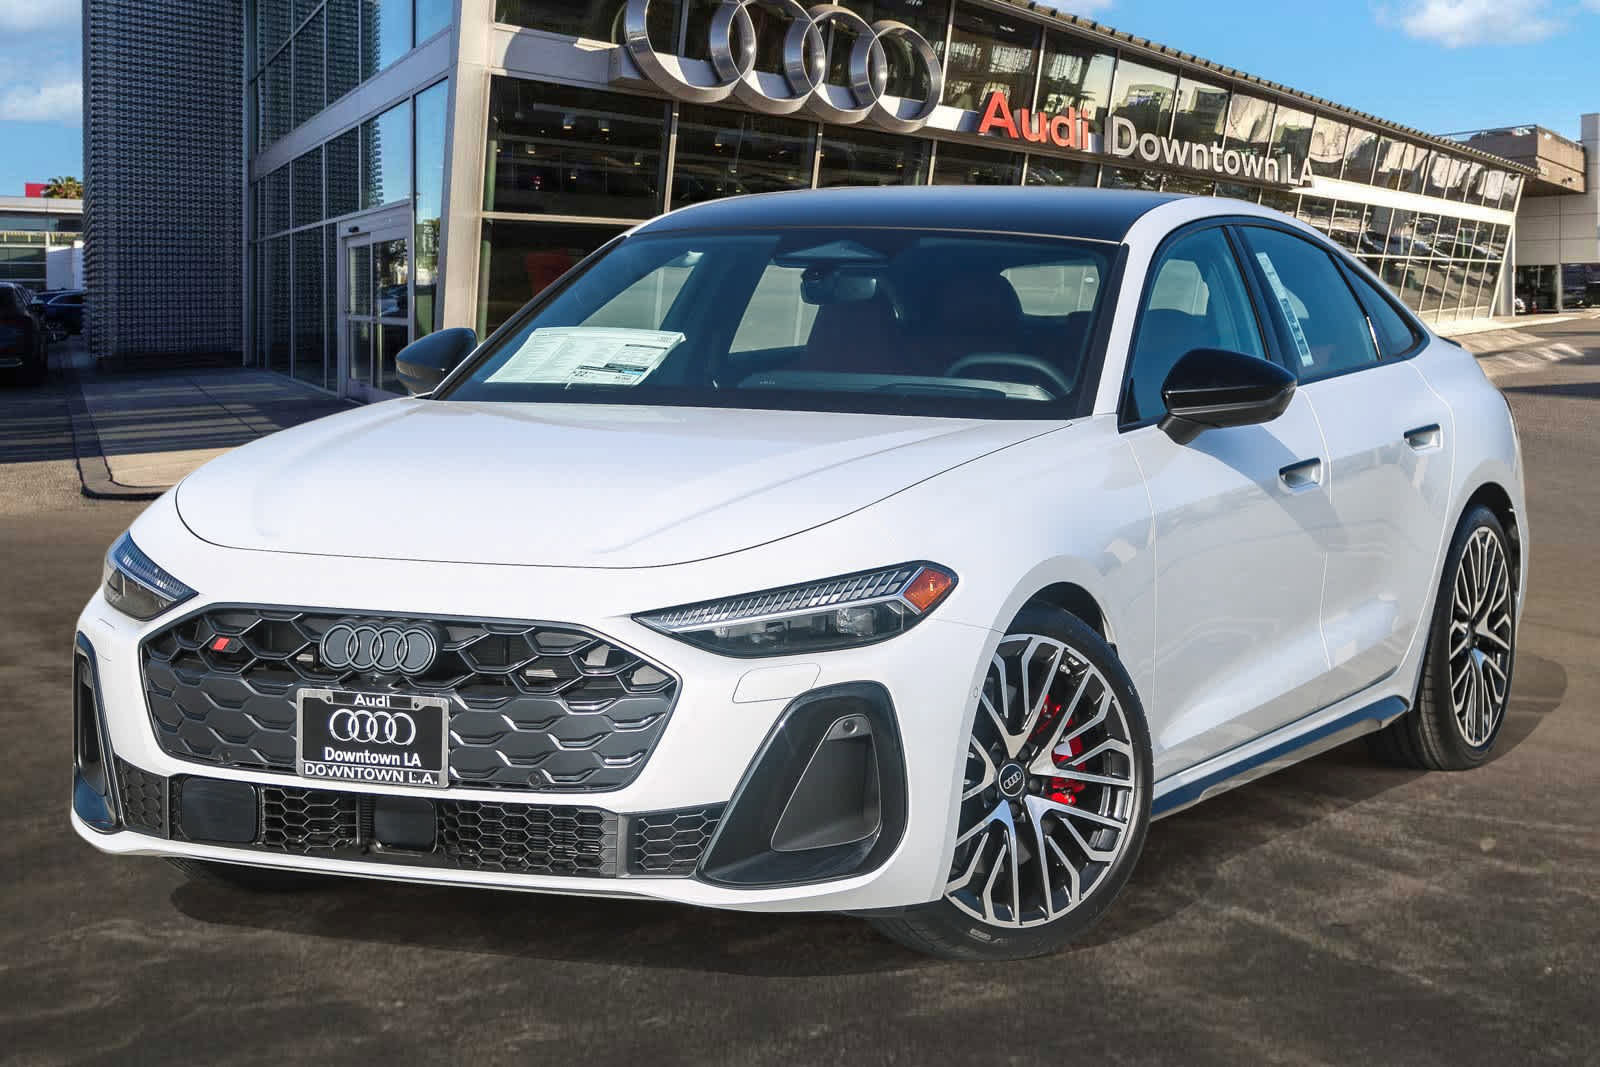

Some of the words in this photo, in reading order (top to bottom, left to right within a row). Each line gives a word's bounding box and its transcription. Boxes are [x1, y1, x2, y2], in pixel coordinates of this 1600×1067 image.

[978, 91, 1089, 150] Audi
[1108, 115, 1280, 184] Downtown
[1286, 153, 1316, 188] LA
[354, 693, 391, 708] Audi
[324, 746, 400, 766] Downtown
[403, 752, 422, 767] LA
[304, 763, 404, 783] DOWNTOWN
[408, 772, 438, 785] L.A.
